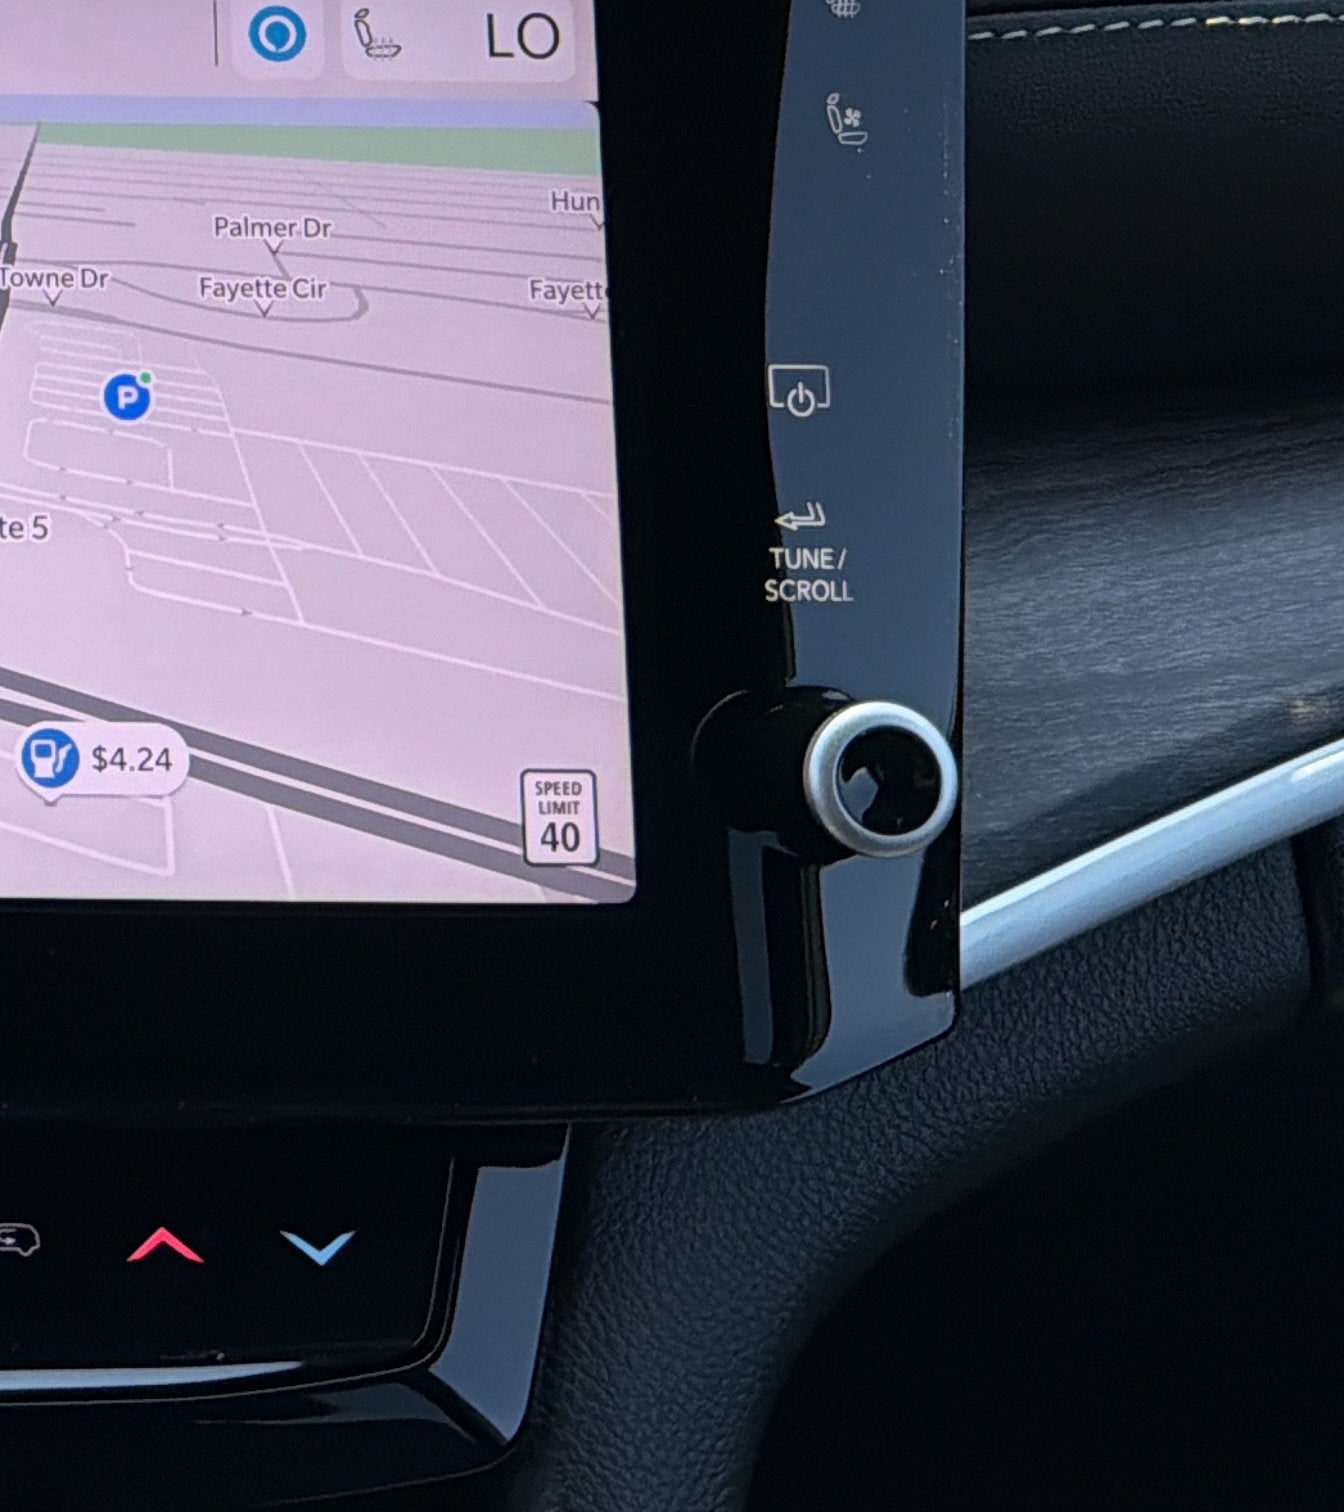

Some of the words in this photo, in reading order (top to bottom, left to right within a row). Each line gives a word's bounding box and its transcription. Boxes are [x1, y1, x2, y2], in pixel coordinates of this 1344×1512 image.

[486, 12, 561, 61] LO
[214, 215, 297, 238] Palmer
[302, 217, 332, 239] Dr
[81, 268, 110, 289] Dr
[200, 276, 287, 302] Fayette
[291, 276, 328, 299] Cir
[31, 515, 49, 541] 5
[768, 546, 848, 571] TUNE/
[764, 579, 854, 603] SCROLL
[91, 743, 174, 774] $4.24
[535, 780, 583, 796] SPEED
[538, 800, 581, 815] LIMIT
[540, 822, 580, 852] 40
